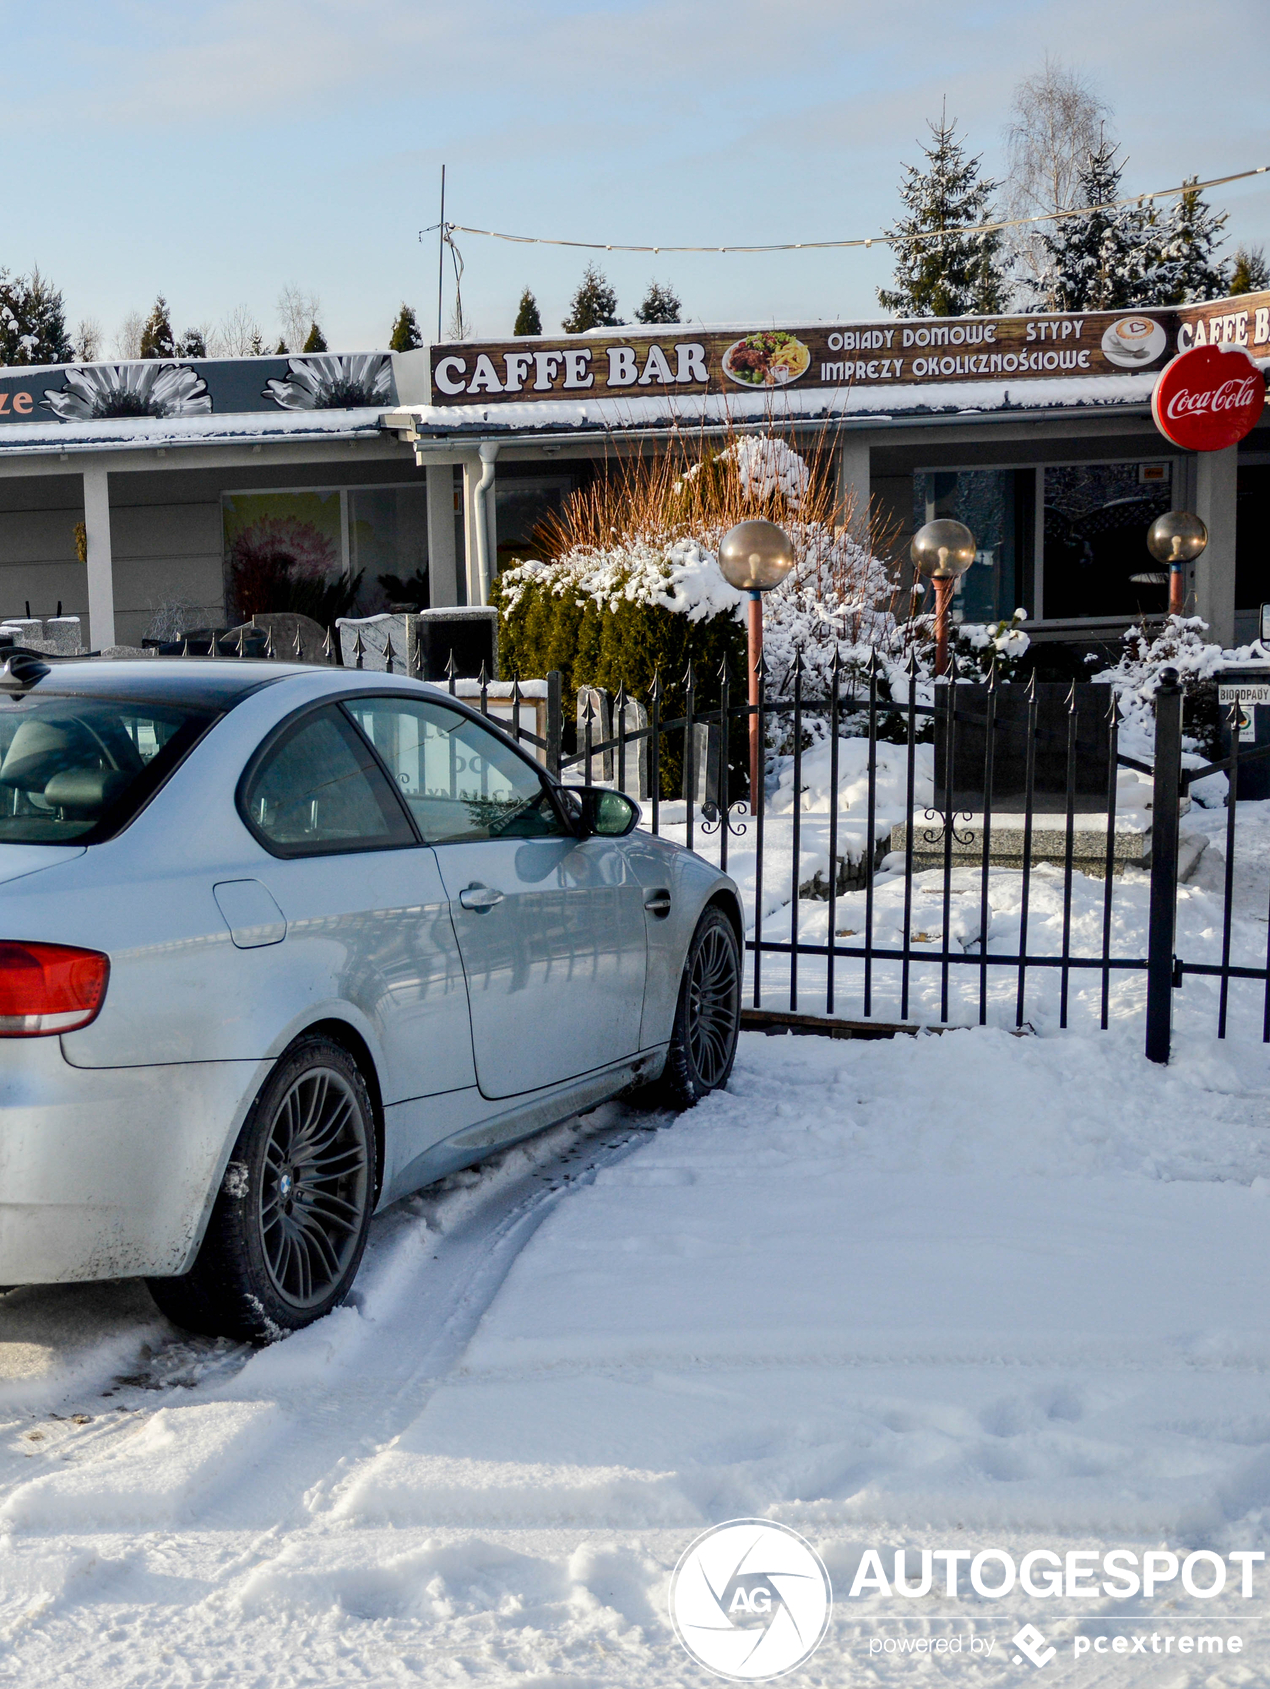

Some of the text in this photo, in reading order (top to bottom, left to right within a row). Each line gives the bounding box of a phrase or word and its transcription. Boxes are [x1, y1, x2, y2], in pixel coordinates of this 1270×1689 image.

[827, 320, 1084, 351] OBIADY DOMOWE STYPY
[1177, 307, 1270, 350] CAFFE B
[434, 341, 710, 395] CAFFE BAR
[820, 347, 1091, 381] IMPREZY OKOLICZNOŚCIOWE
[1167, 376, 1258, 419] Coca-Cola
[1220, 688, 1269, 700] BIOODPADY
